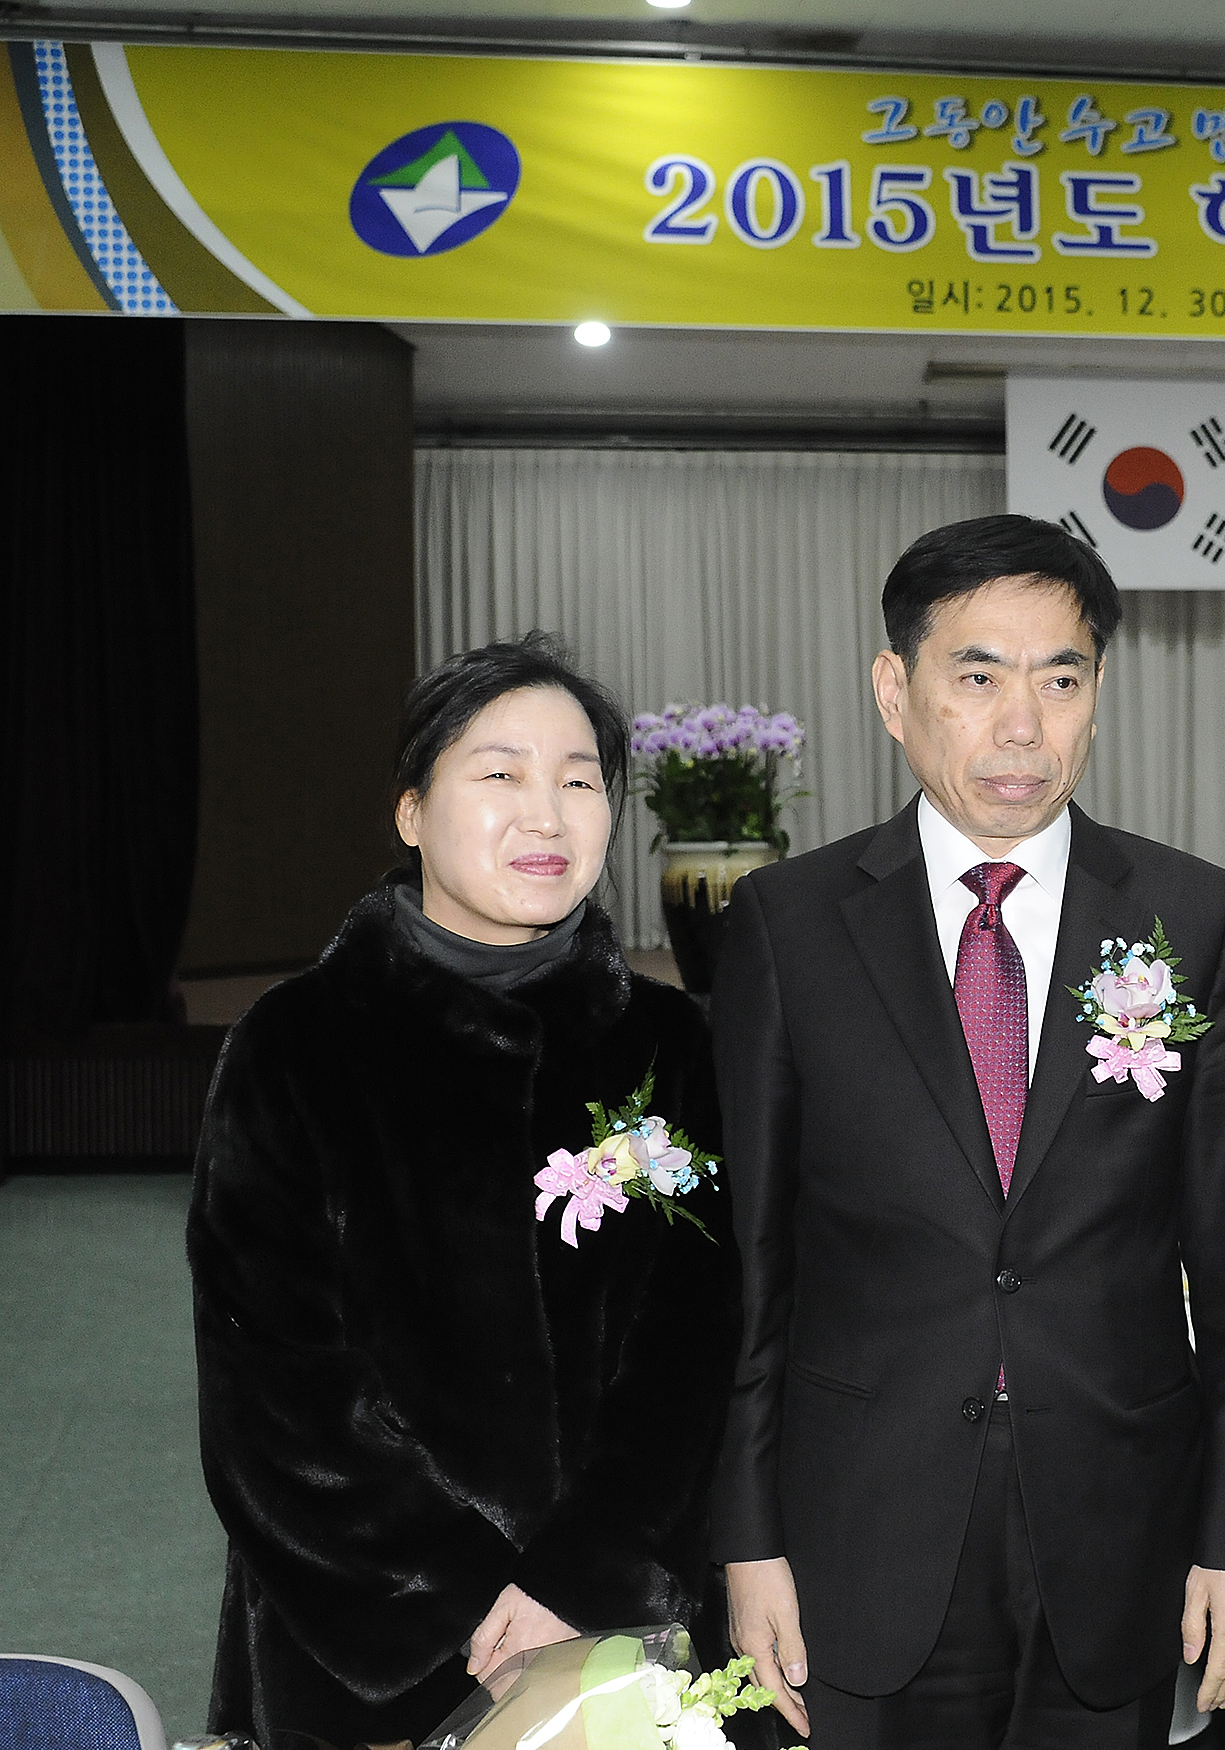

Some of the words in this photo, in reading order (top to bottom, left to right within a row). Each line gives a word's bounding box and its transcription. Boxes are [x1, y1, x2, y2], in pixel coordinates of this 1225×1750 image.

[862, 95, 1045, 157] 그동안
[1058, 93, 1177, 156] 수고
[645, 153, 1158, 264] 2015년도
[906, 278, 984, 315] 일시:
[995, 283, 1094, 317] 2015.
[1118, 286, 1169, 319] 12.
